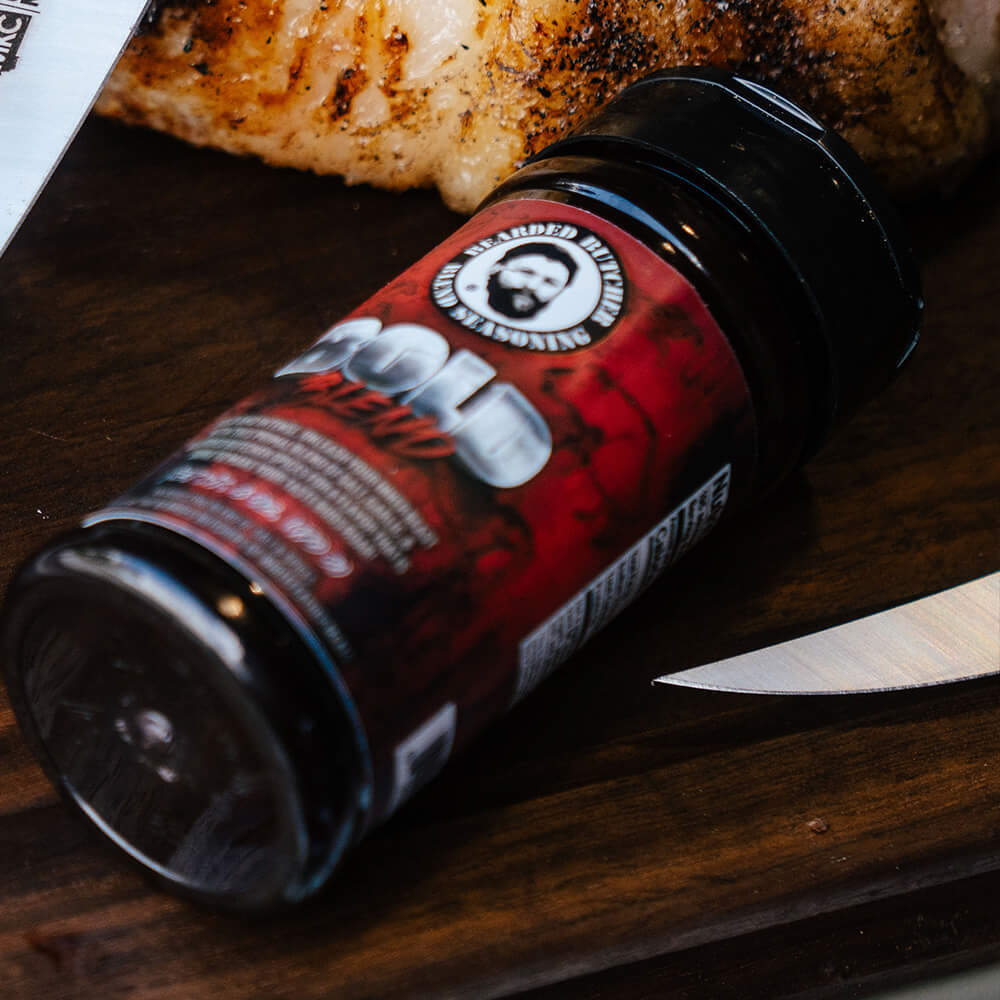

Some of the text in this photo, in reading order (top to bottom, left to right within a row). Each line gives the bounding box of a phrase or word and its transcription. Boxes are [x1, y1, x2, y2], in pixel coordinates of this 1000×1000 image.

[463, 223, 625, 328] BEARDED BUTCHER
[450, 306, 592, 351] SEASONING
